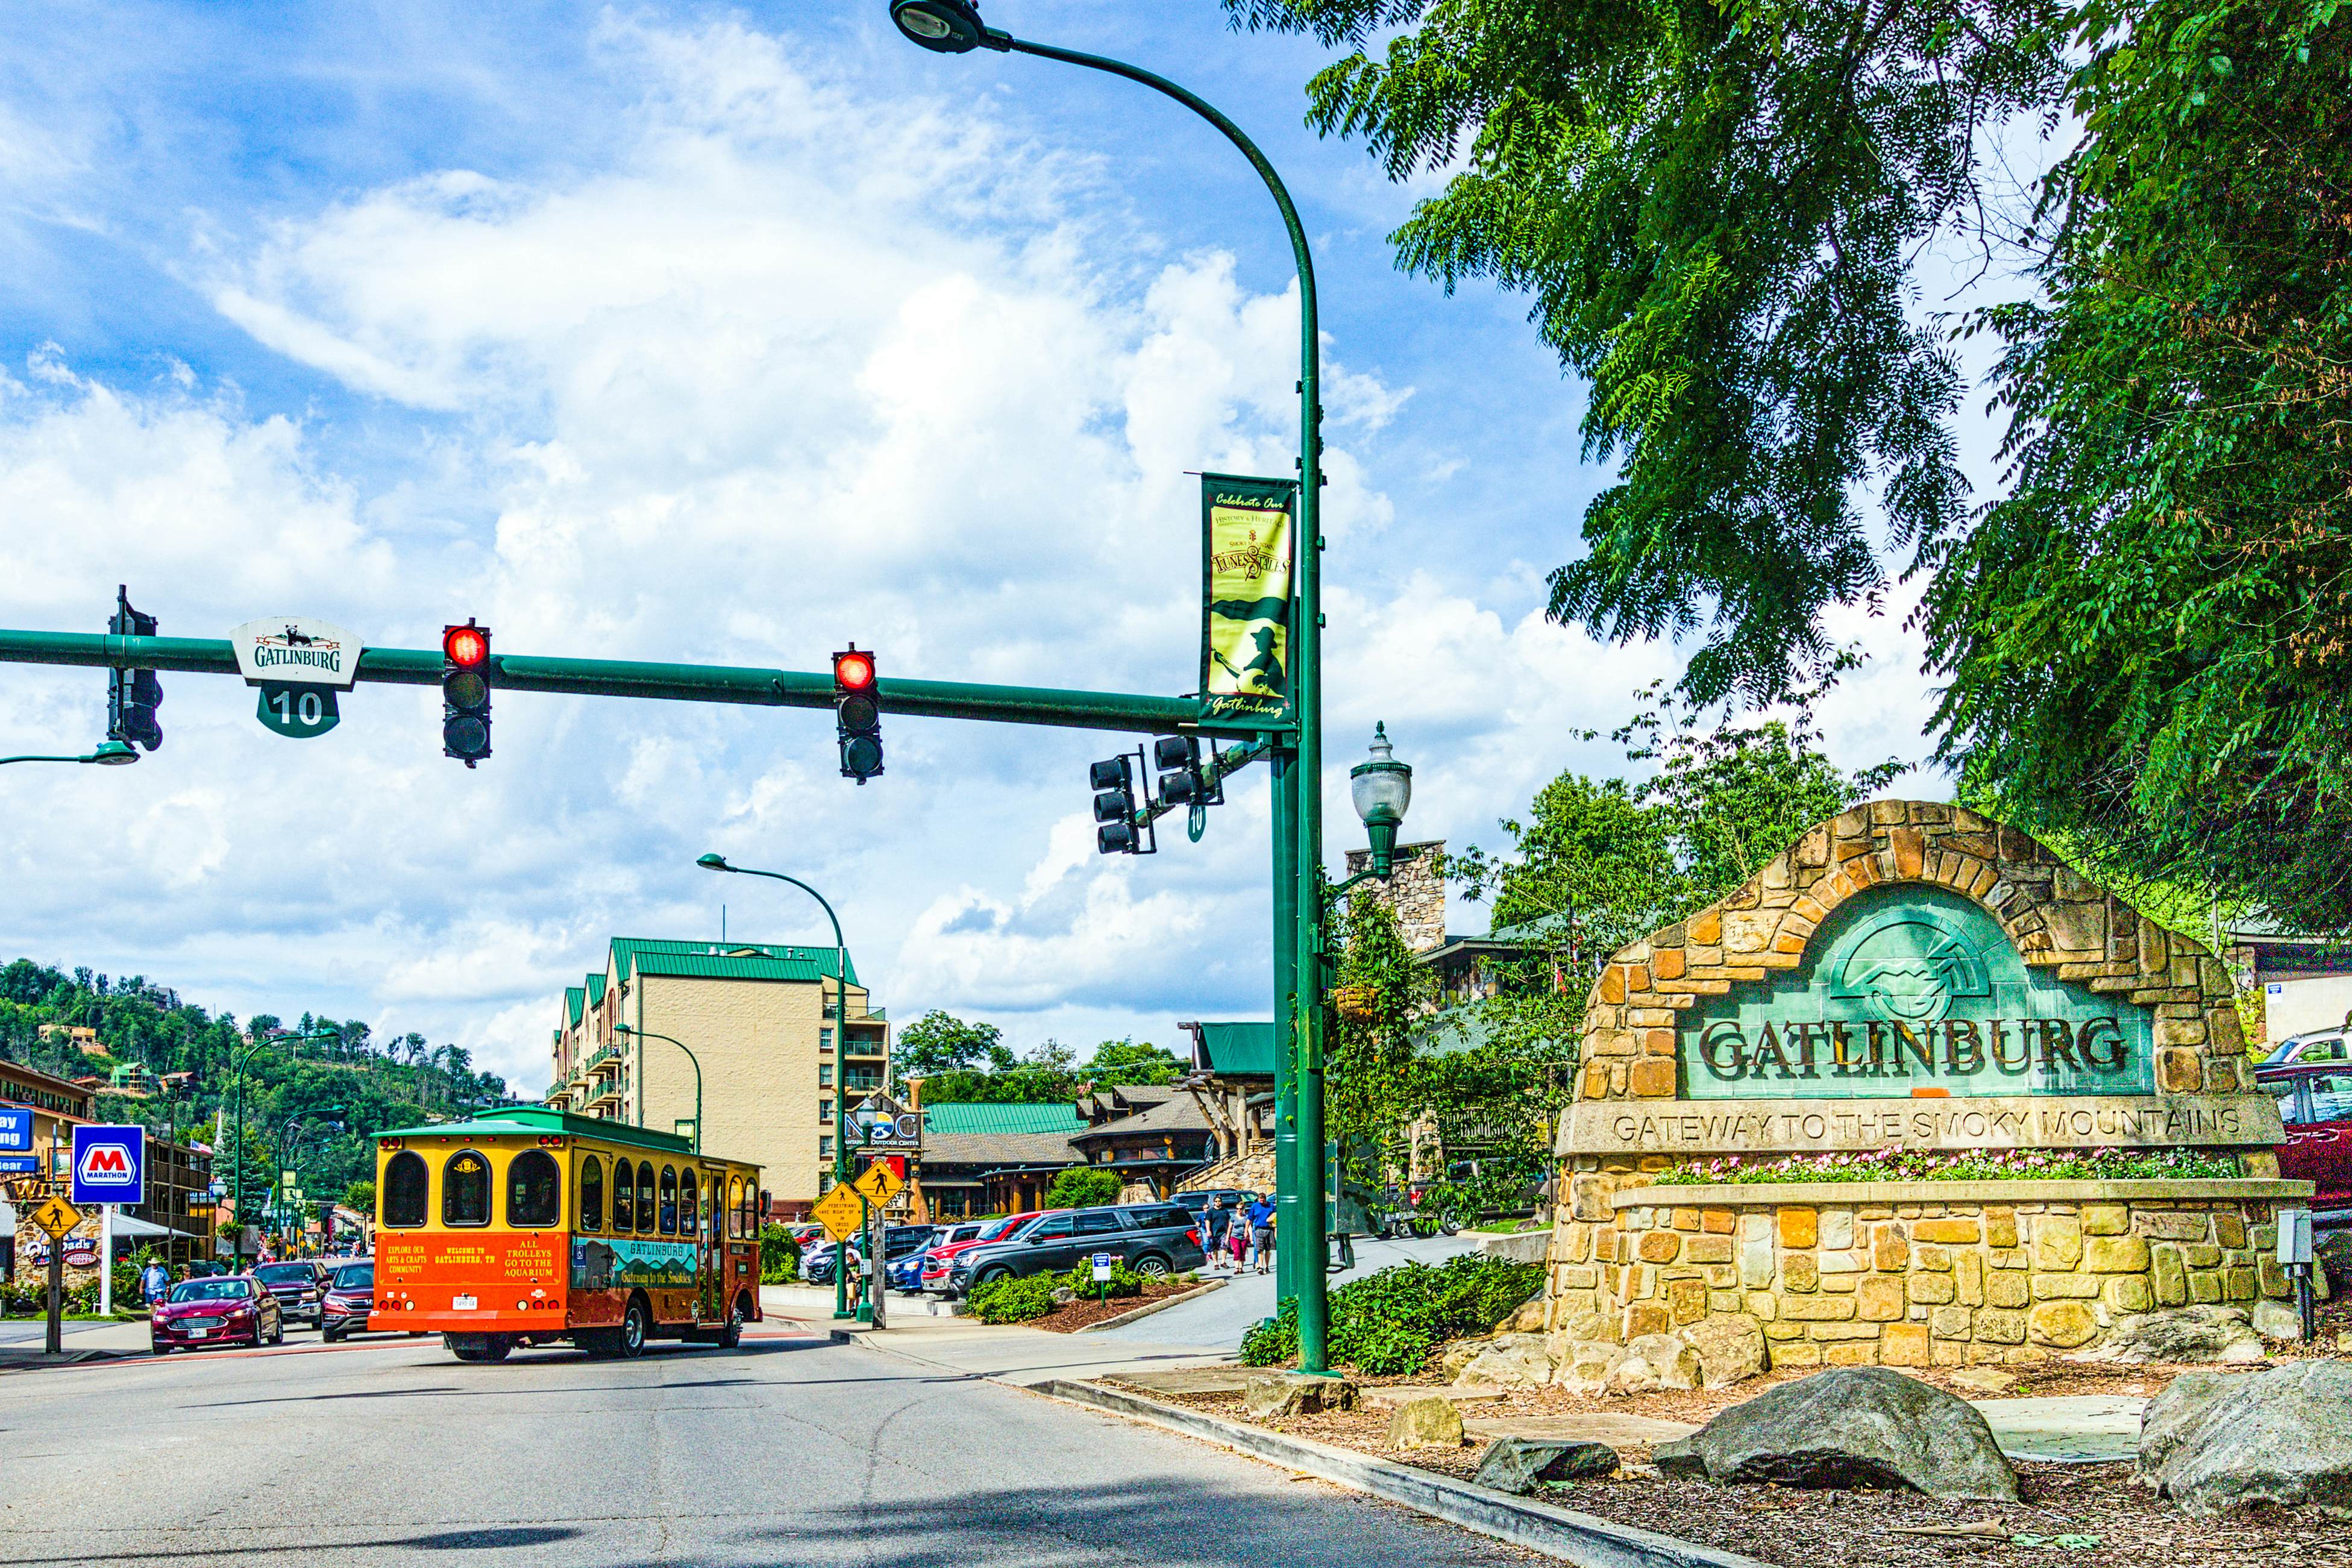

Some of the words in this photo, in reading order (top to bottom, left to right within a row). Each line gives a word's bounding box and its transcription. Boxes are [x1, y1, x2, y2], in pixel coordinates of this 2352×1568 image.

[1216, 493, 1261, 506] Celebrate
[1264, 498, 1284, 508] Our
[1215, 516, 1244, 524] HISTORY
[1252, 515, 1284, 528] HERITAGE
[1212, 554, 1248, 571] TUNES
[1258, 556, 1290, 574] TALES
[254, 646, 340, 673] GATLINBURG
[273, 691, 322, 726] 10
[1212, 697, 1282, 718] Gatlinburg
[1191, 806, 1202, 833] 10
[1699, 1016, 2126, 1067] GATLINBURG
[1614, 1115, 1773, 1141] GATEWAY
[1782, 1114, 1824, 1139] TO
[1836, 1114, 1901, 1138] THE
[1912, 1111, 2029, 1138] SMOKY
[2042, 1108, 2240, 1135] MOUNTAINS
[630, 1243, 683, 1256] GATLINBURG
[504, 1269, 553, 1277] AQUARIUM
[621, 1270, 648, 1286] Gateway
[650, 1272, 656, 1283] to
[657, 1272, 666, 1283] the
